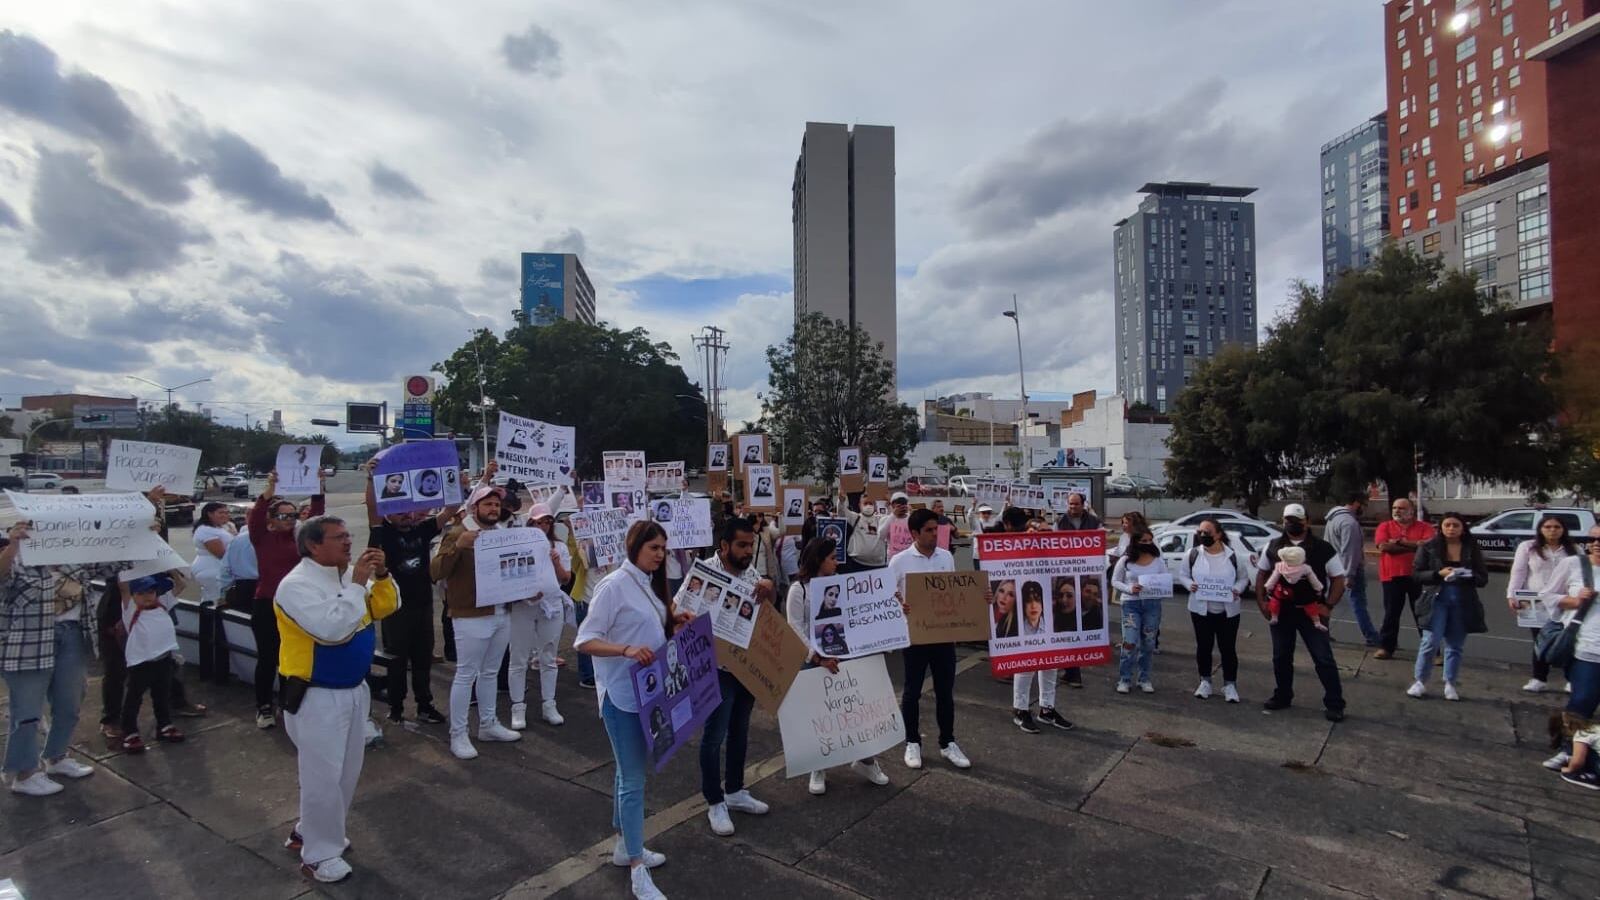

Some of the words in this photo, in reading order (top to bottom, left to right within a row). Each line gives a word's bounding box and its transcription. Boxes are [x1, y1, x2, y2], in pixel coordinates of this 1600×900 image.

[35, 517, 91, 533] Daniela
[983, 536, 1101, 553] DESAPARECIDOS
[1023, 567, 1061, 576] QUEREMOS
[1072, 565, 1105, 573] REGRESO
[1051, 558, 1087, 567] LLEVARON
[846, 574, 884, 601] Paola
[845, 606, 858, 618] TE
[859, 597, 899, 613] ESTAMOS
[849, 610, 902, 629] BUSCANDO
[994, 641, 1021, 650] VIVIANA
[1024, 638, 1046, 646] PAOLA
[1050, 635, 1081, 644] DANIELA
[997, 659, 1037, 671] AYUDANOS
[1045, 655, 1075, 665] LLEGAR
[1076, 653, 1083, 661] A
[1083, 652, 1105, 660] CASA
[823, 667, 858, 696] Paola
[840, 735, 855, 748] LA
